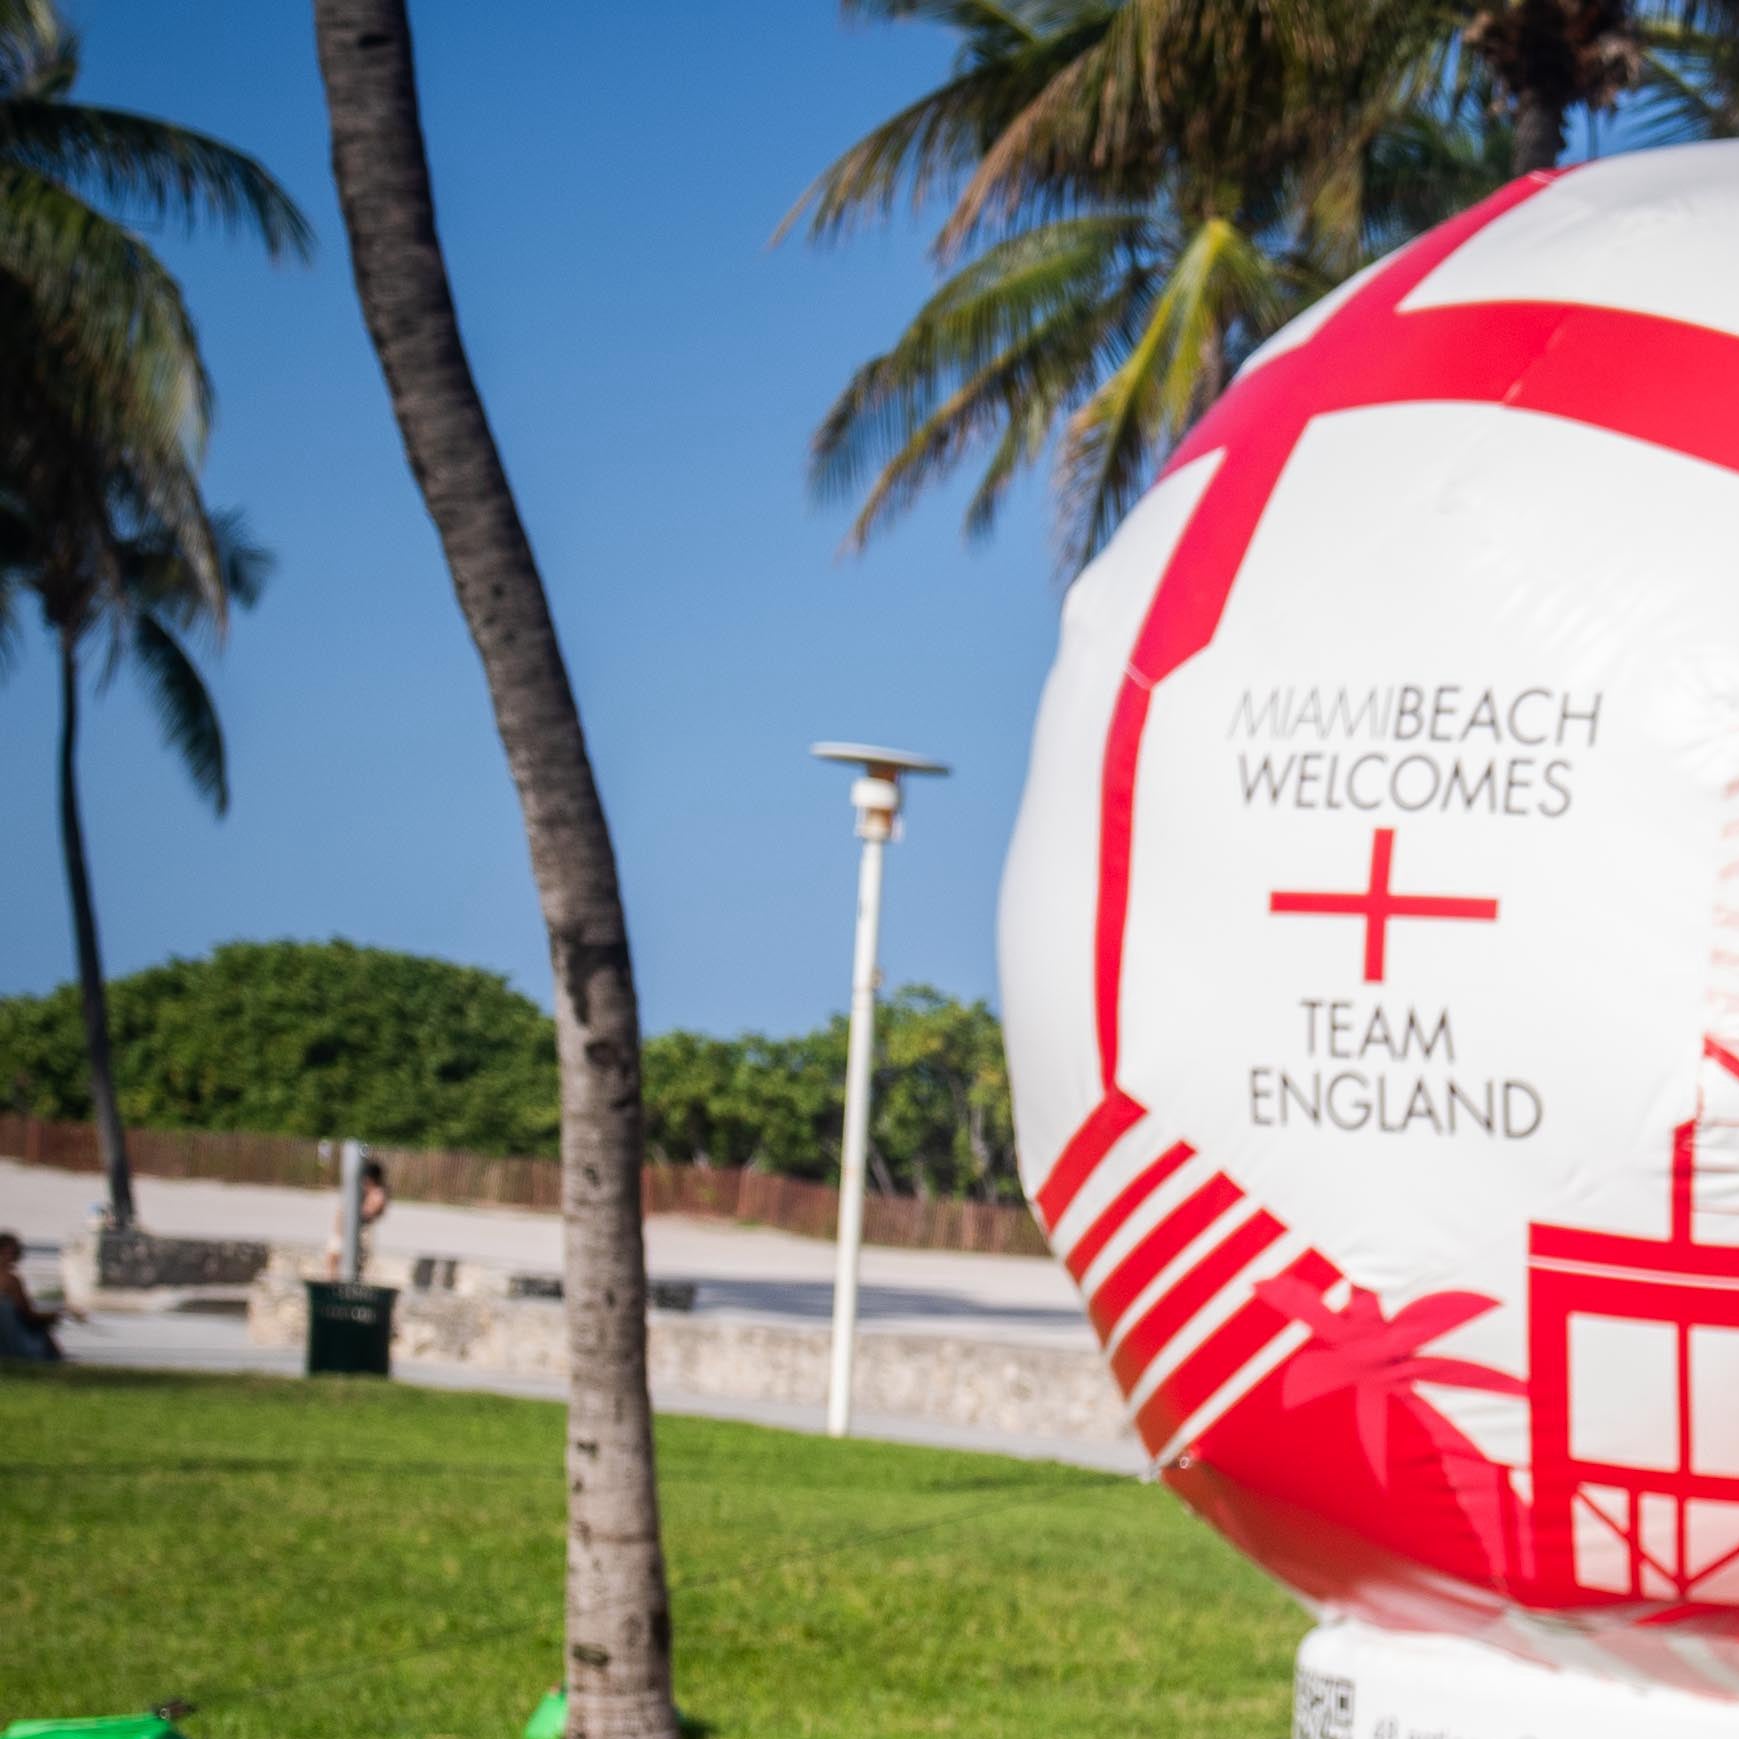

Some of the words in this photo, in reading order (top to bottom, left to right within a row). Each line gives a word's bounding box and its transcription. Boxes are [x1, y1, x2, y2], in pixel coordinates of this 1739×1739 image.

[1237, 753, 1574, 818] WELCOMES
[1300, 999, 1456, 1063] TEAM
[1248, 1067, 1544, 1140] ENGLAND
